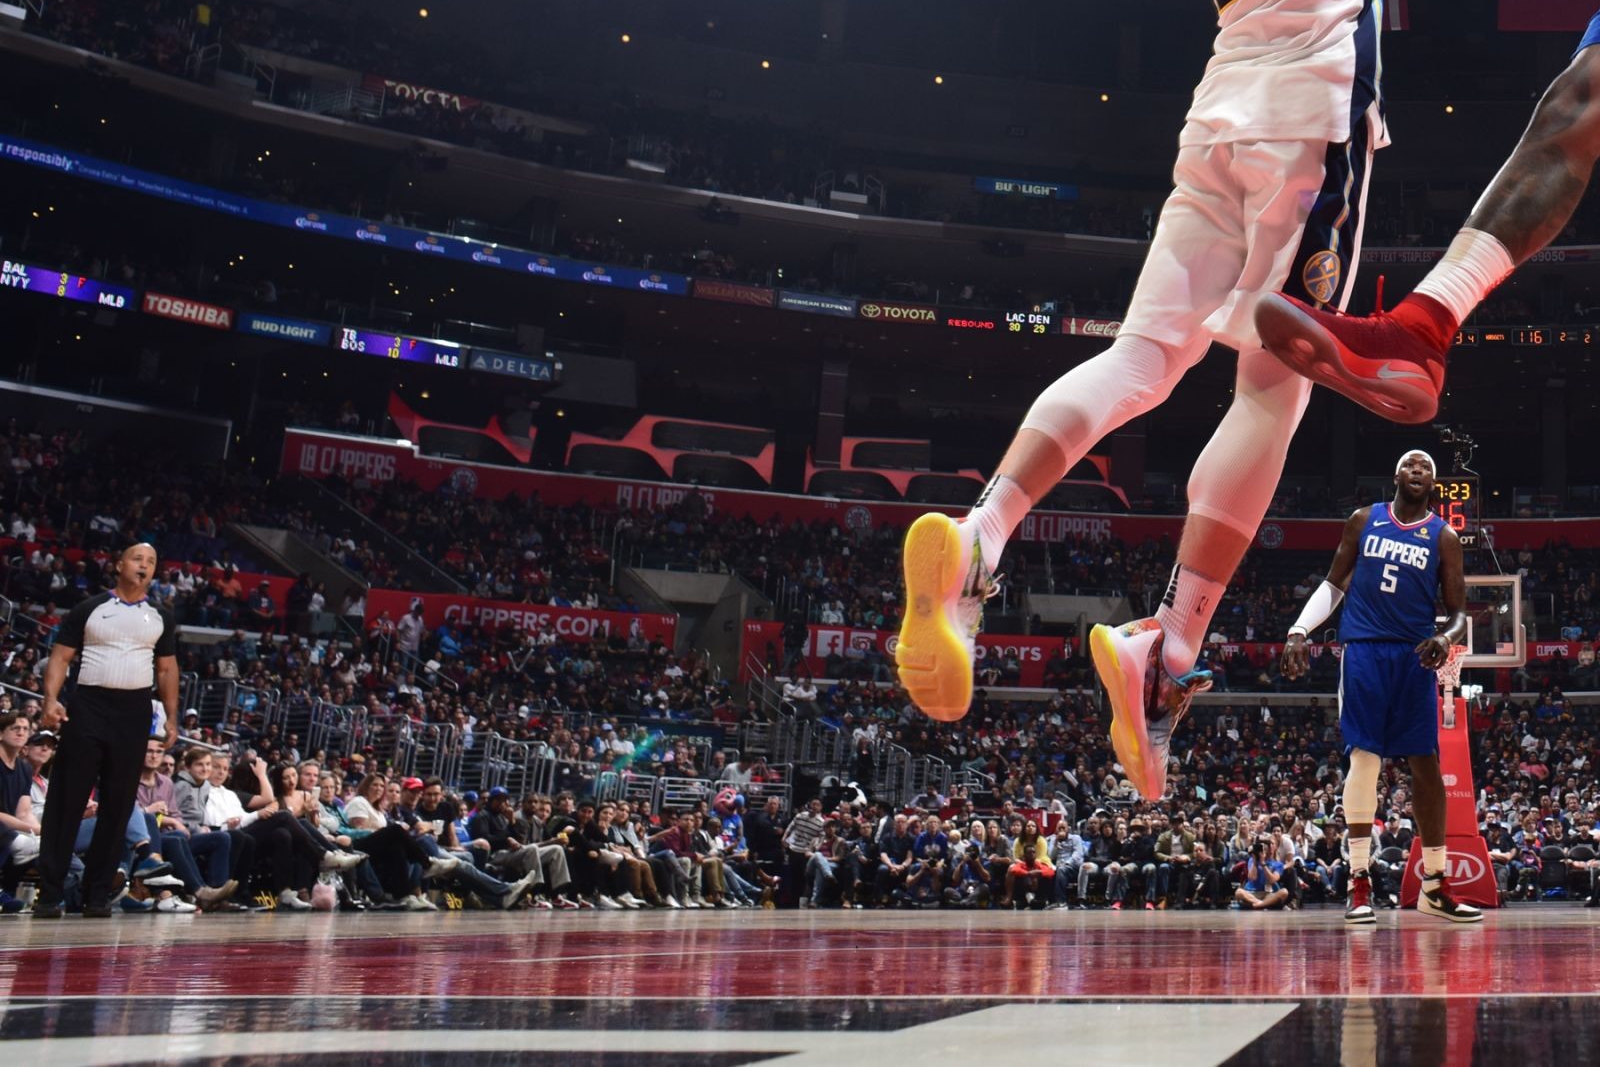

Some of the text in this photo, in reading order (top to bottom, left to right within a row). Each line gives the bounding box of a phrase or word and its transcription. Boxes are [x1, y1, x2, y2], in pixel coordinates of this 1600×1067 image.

[2, 260, 87, 288] BAL 3 F
[0, 274, 66, 298] NYY 8
[98, 292, 125, 308] MLB
[146, 293, 231, 328] TOSHIBA
[883, 306, 936, 322] TOYOTA
[948, 318, 994, 330] REBOUND
[1006, 311, 1050, 325] LAC DEN
[251, 318, 317, 340] BUD LIGHT
[342, 327, 417, 350] TB 3 F
[1008, 322, 1045, 334] 30 29
[341, 339, 399, 359] BOS 10
[435, 353, 459, 367] MLB
[492, 354, 551, 378] DELTA
[320, 445, 397, 481] CLIPPERS
[1439, 501, 1466, 531] 16
[1363, 534, 1430, 571] CLIPPERS
[1379, 563, 1399, 594] 5
